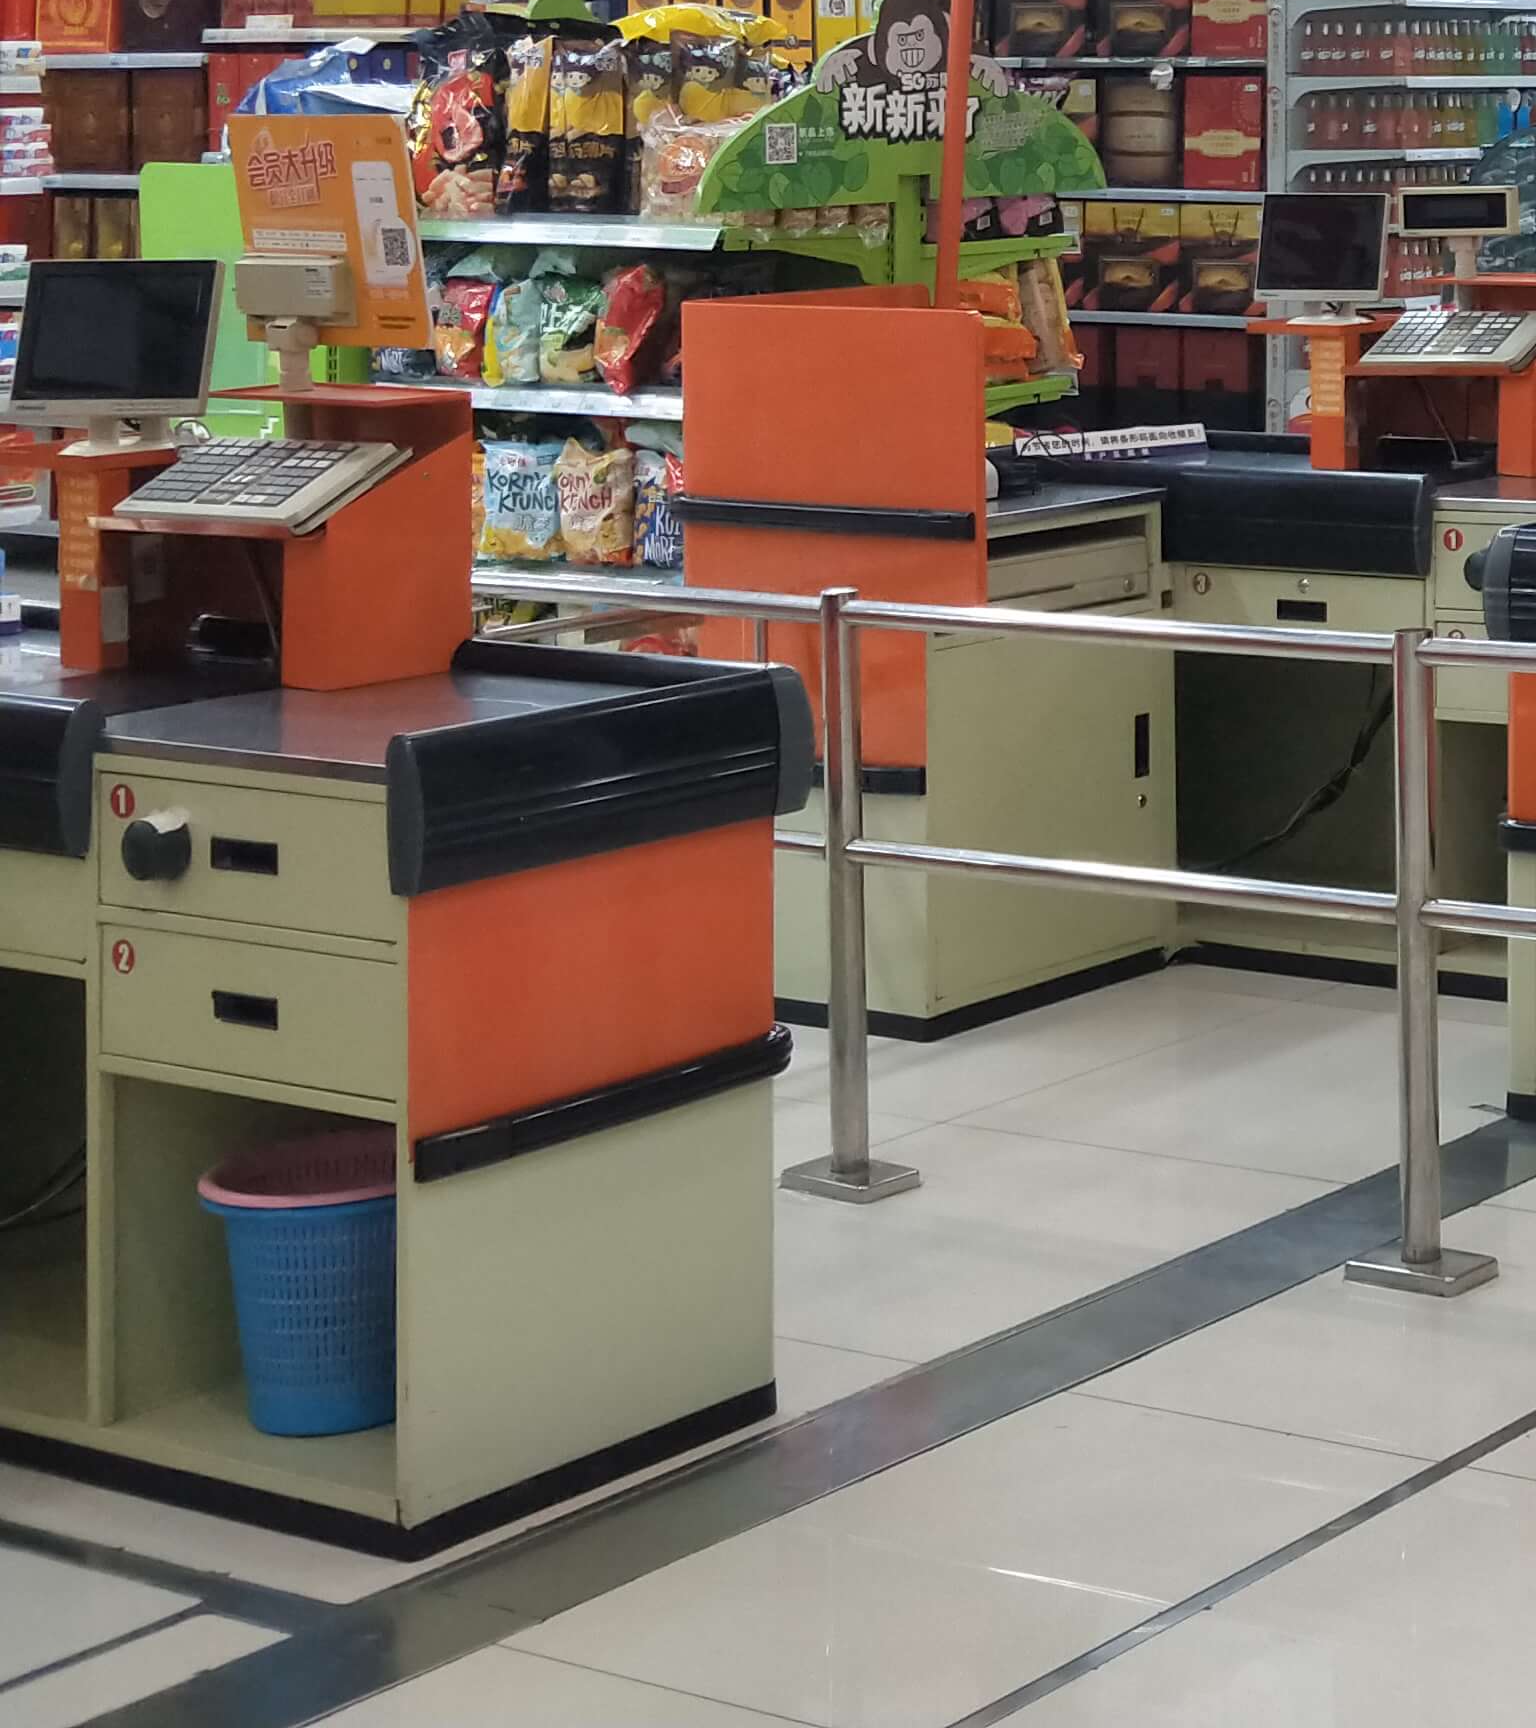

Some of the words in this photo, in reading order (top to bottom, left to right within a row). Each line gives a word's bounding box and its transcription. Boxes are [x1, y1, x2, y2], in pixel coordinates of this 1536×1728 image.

[247, 134, 337, 200] 会员大升级
